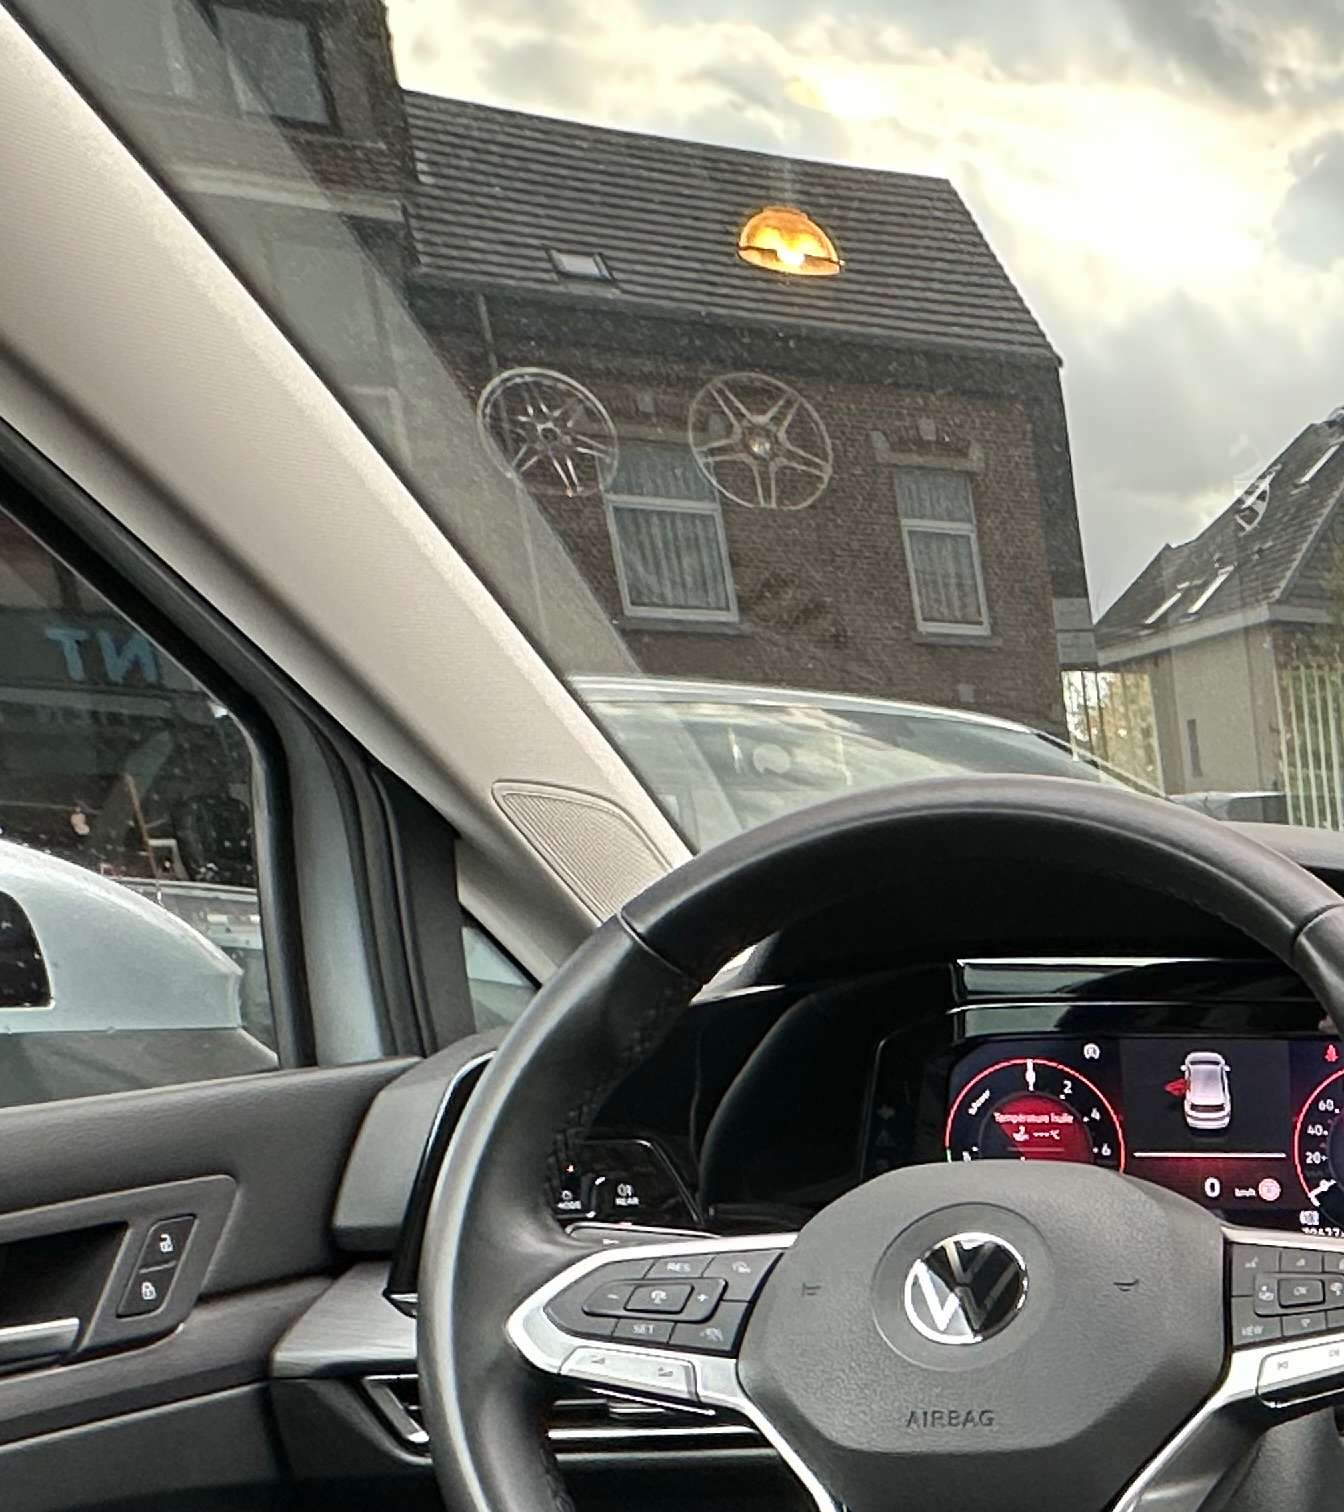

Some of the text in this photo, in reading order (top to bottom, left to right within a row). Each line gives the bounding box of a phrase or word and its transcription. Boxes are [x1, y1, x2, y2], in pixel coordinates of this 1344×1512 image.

[1063, 1080, 1073, 1094] 2
[1307, 1125, 1323, 1136] 40
[1101, 1143, 1112, 1156] 6
[1305, 1152, 1321, 1164] 20
[1204, 1177, 1221, 1198] 0
[667, 1263, 691, 1272] RES
[633, 1325, 654, 1334] SET
[905, 1409, 995, 1428] AIRBAG
